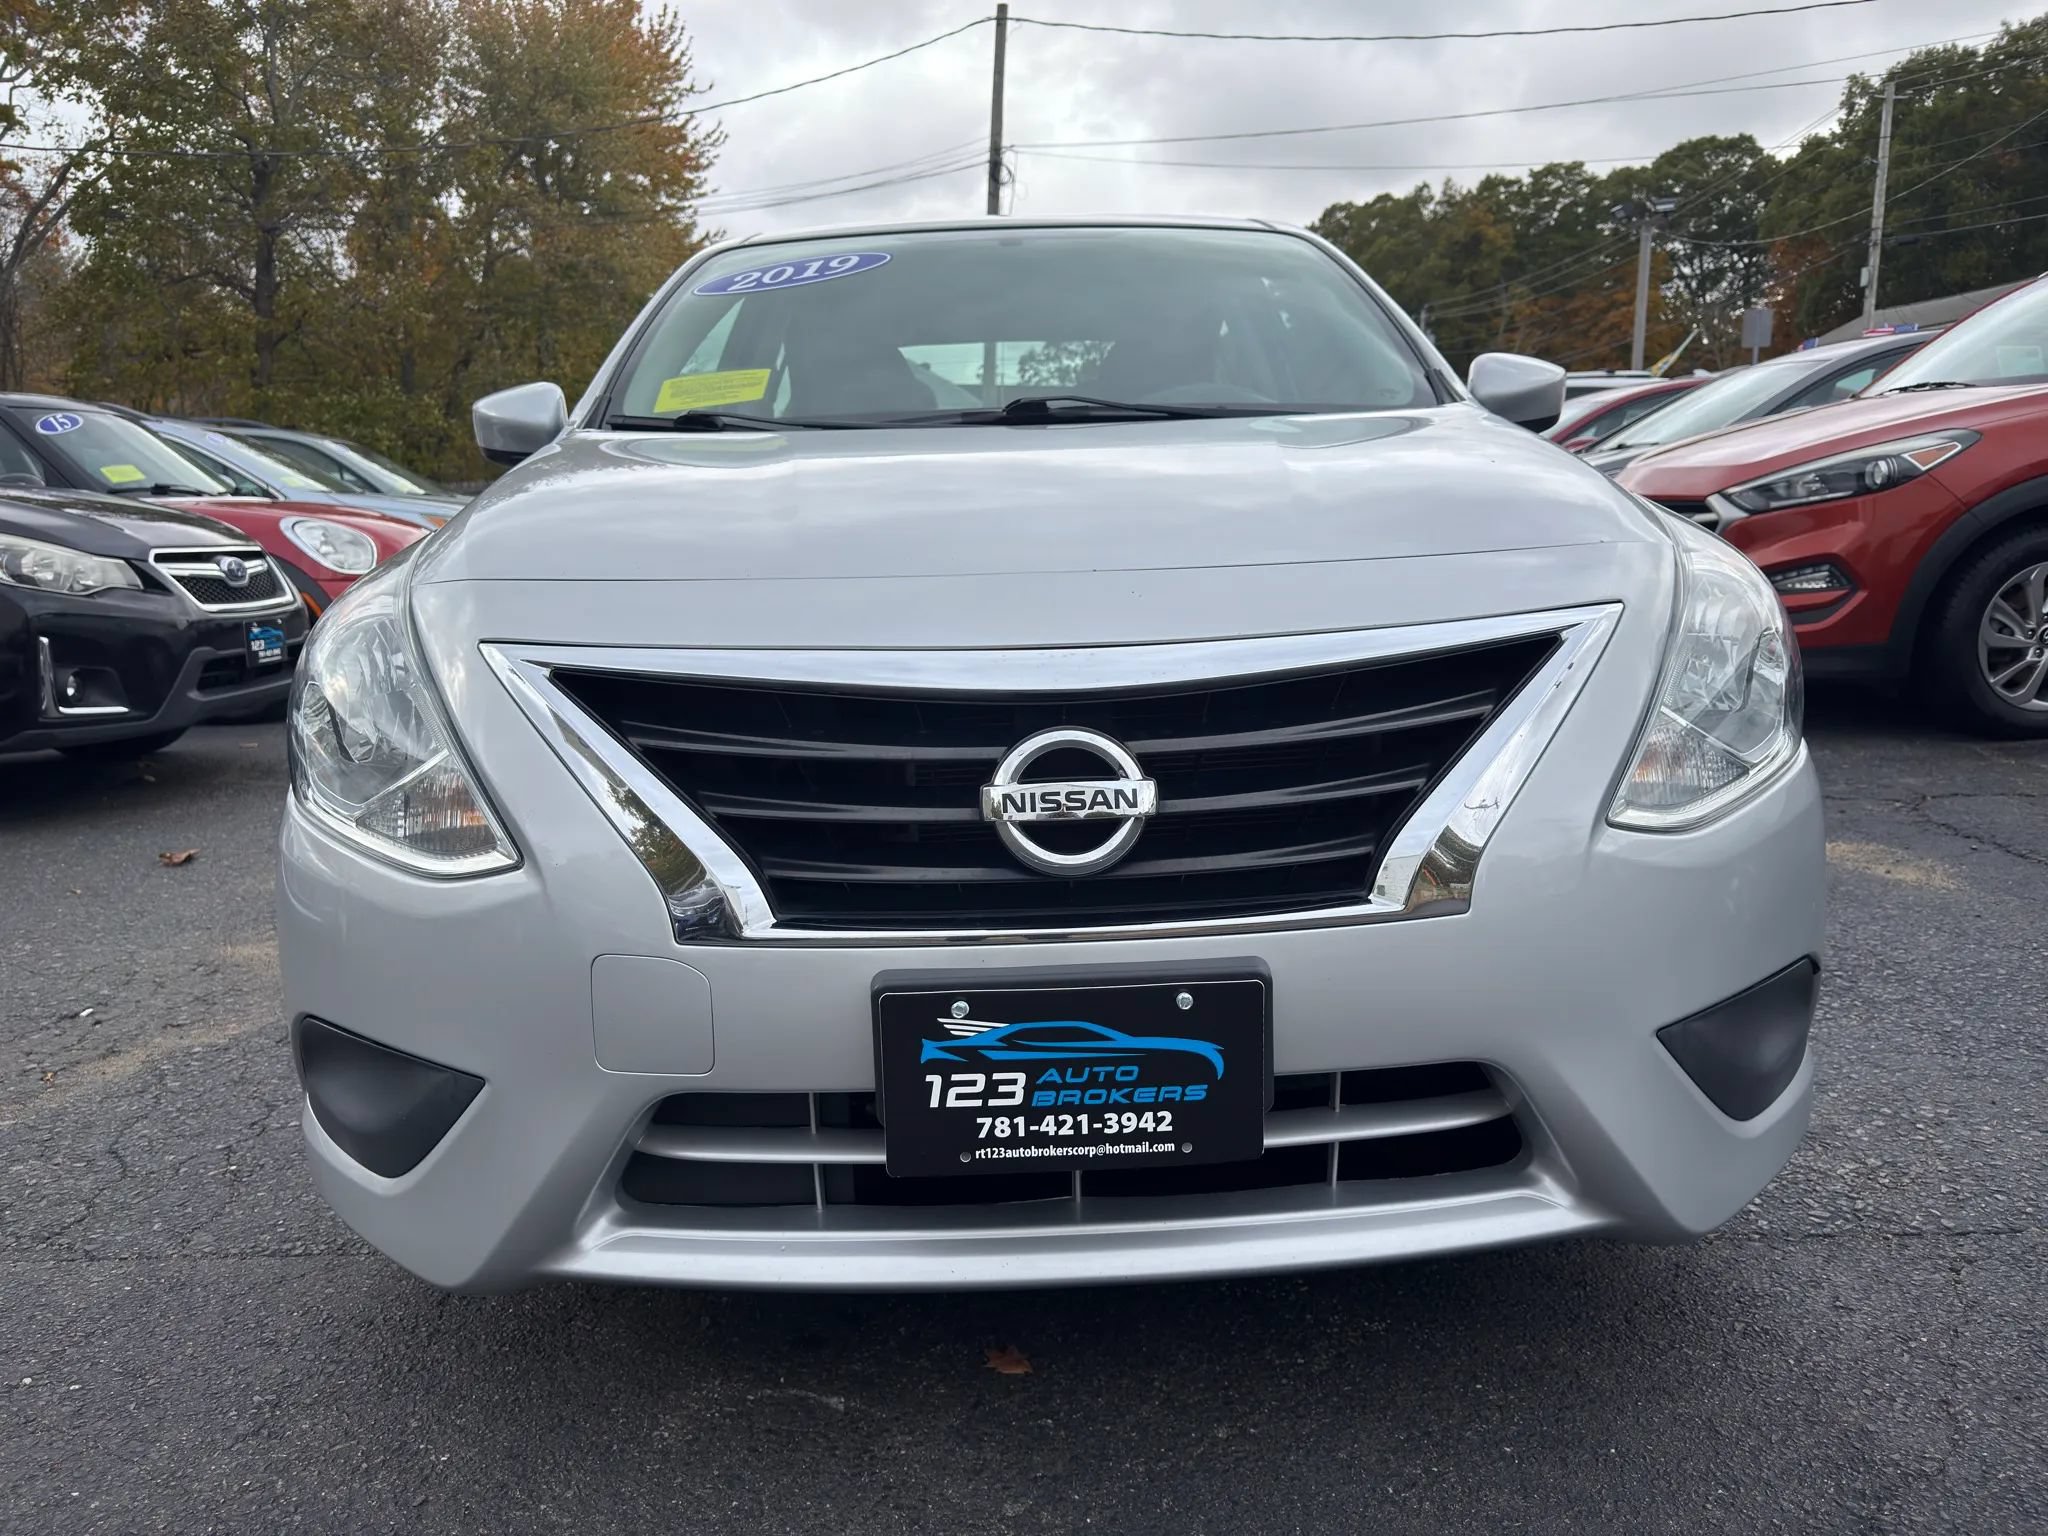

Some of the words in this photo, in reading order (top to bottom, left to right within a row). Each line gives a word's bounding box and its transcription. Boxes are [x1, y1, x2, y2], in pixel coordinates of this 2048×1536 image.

[727, 255, 860, 291] 2019
[48, 414, 72, 432] 15
[1001, 788, 1138, 814] NISSAN
[1036, 1065, 1139, 1084] AUTO
[924, 1072, 1027, 1108] 123
[1031, 1084, 1208, 1107] BROKERS
[976, 1111, 1173, 1138] 781-421-3942
[975, 1142, 1175, 1159] rt123autobrokerscorp@hotmail.com
